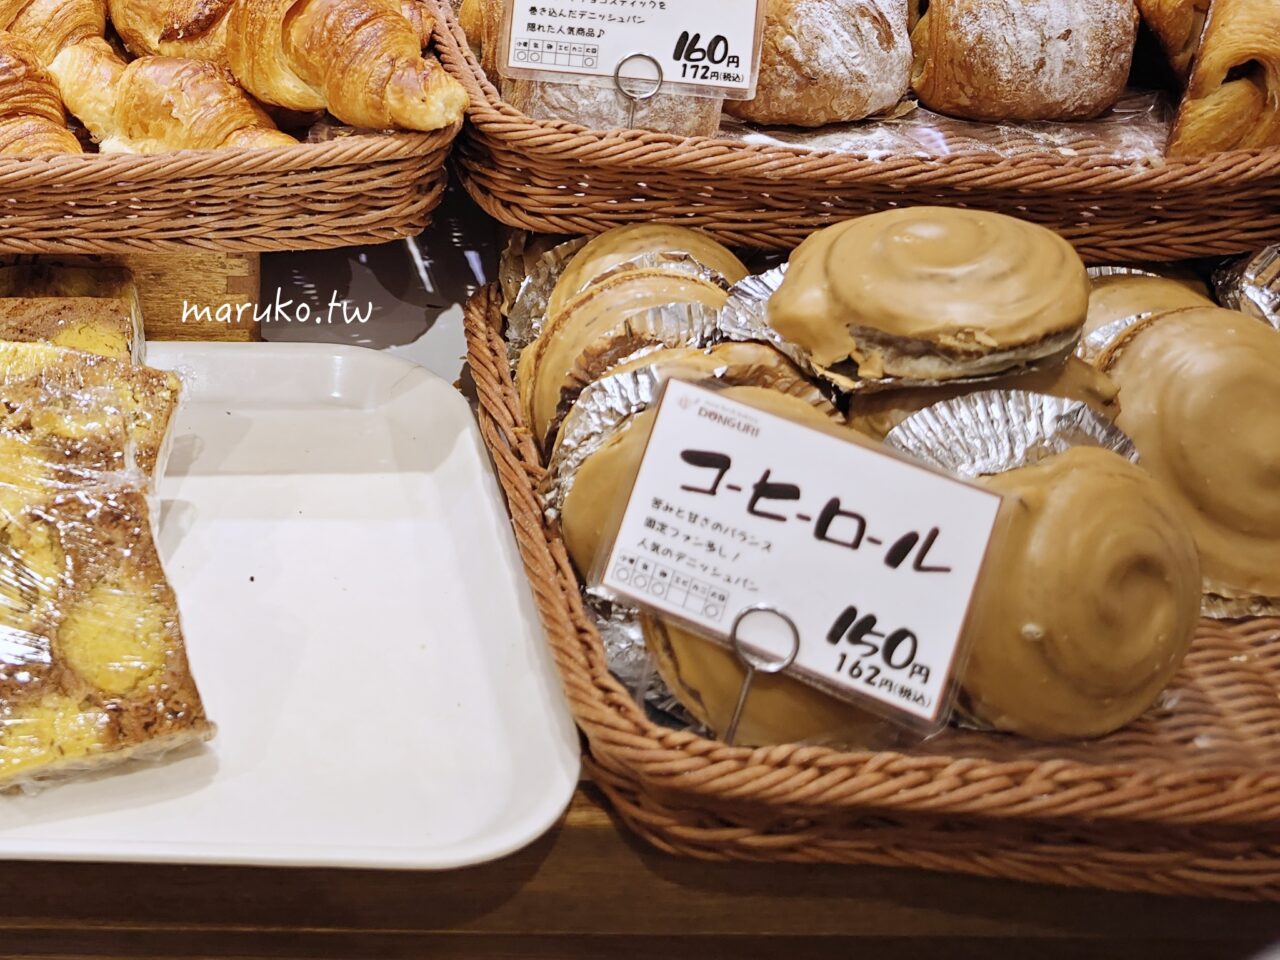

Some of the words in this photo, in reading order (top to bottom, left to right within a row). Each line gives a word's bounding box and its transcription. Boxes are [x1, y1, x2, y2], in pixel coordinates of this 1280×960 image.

[529, 6, 646, 24] 巻き込んだデニッシュパン
[673, 31, 740, 67] 160円
[698, 406, 760, 437] DONGURI
[680, 450, 952, 572] コーヒーロール
[637, 538, 759, 592] 人気のデニッシュパン
[826, 605, 930, 684] 150円
